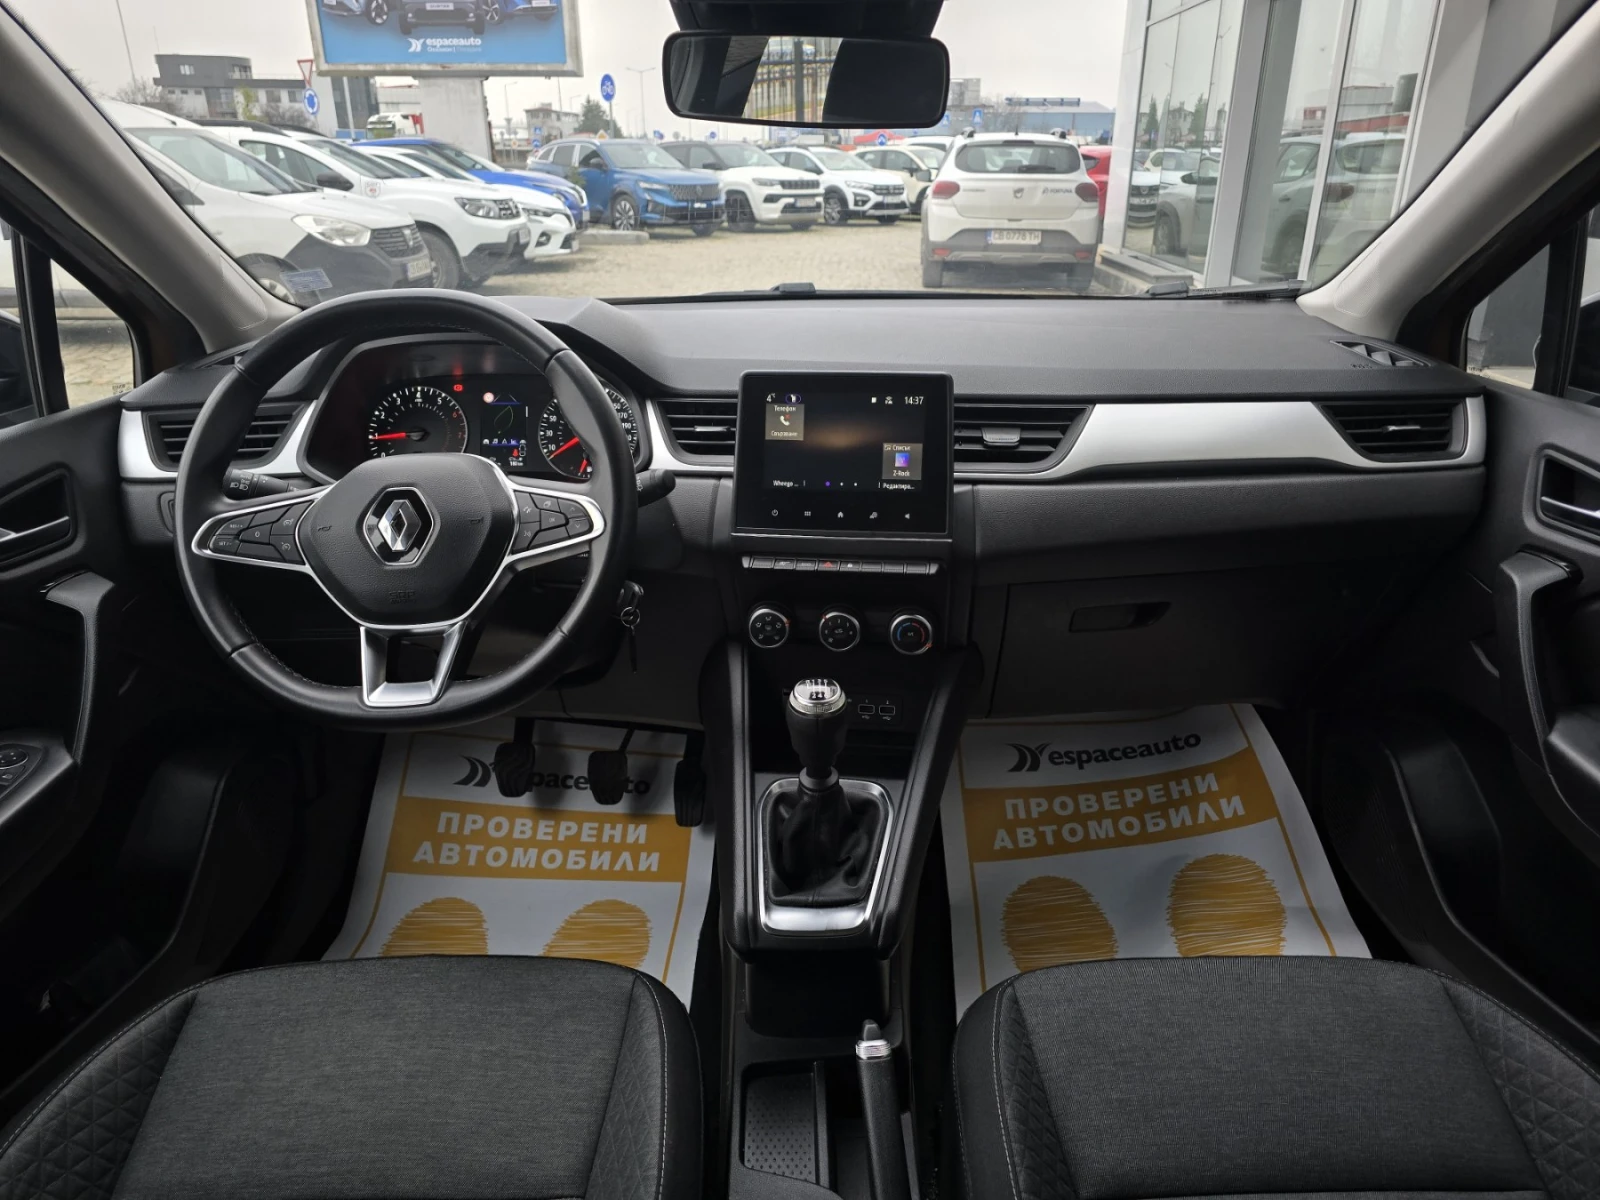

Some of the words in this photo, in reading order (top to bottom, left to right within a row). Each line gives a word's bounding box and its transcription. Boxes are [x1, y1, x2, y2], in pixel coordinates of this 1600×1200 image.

[426, 37, 482, 48] espaceauto
[395, 397, 401, 405] 3
[437, 397, 442, 405] 5
[904, 395, 924, 405] 14:37
[380, 411, 385, 419] 2
[549, 415, 557, 423] 50
[545, 429, 553, 437] 30
[1048, 732, 1202, 770] espaceauto
[1004, 772, 1219, 820] ПРОВЕРЕНИ
[993, 795, 1246, 850] АВТОМОБИЛИ
[437, 811, 648, 845] ПРОВЕРЕНИ
[412, 842, 661, 873] АВТОМОБИЛИ
